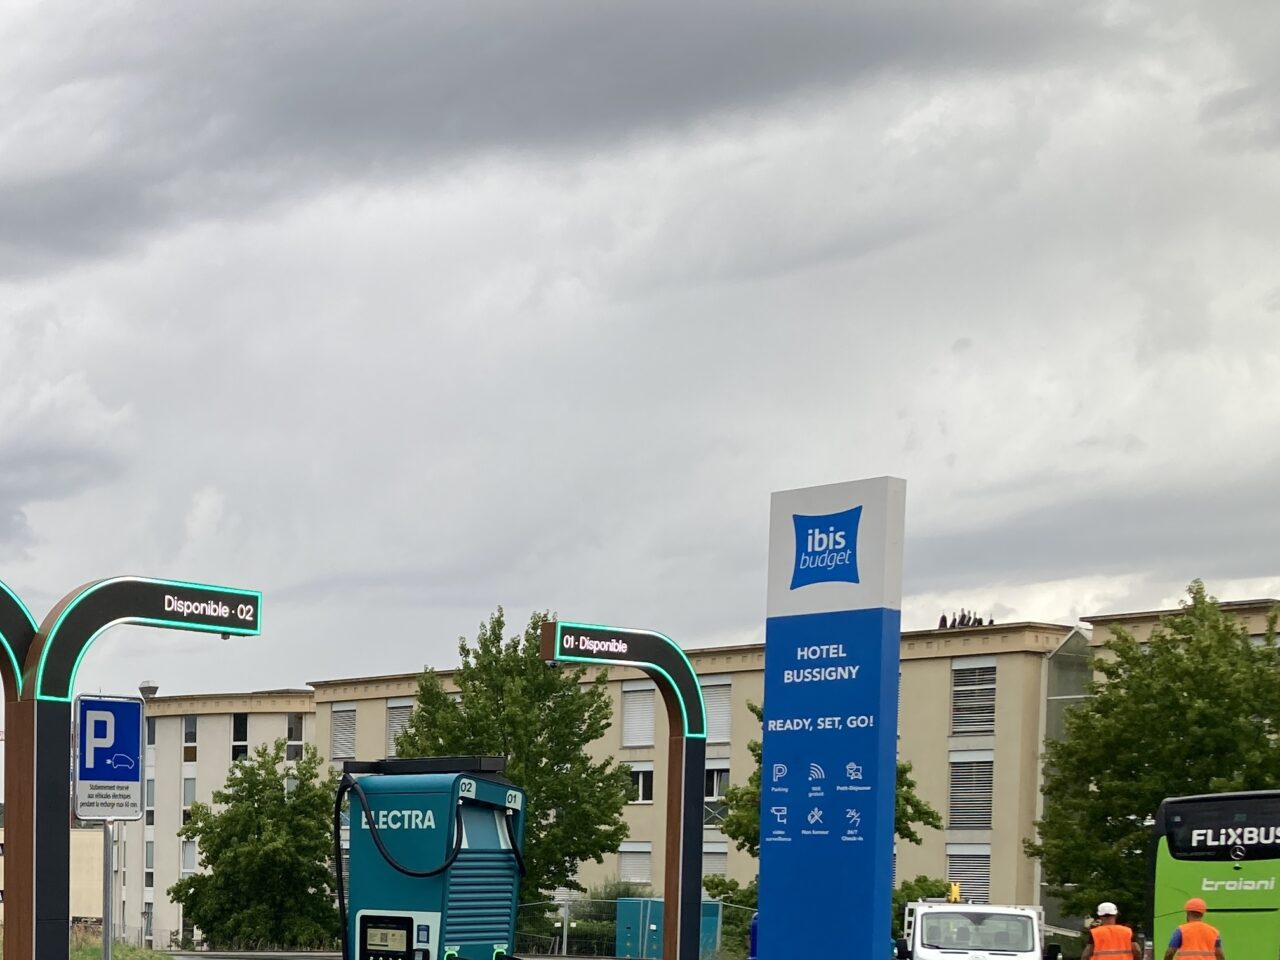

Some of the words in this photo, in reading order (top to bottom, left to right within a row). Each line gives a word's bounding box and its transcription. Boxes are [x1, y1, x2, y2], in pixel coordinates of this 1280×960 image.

[807, 526, 846, 553] ibis
[800, 549, 852, 571] budget
[164, 594, 230, 617] Disponible
[237, 603, 254, 621] 02
[563, 635, 575, 649] 01
[579, 635, 628, 654] Disponible
[797, 644, 847, 660] HOTEL
[784, 665, 860, 684] BUSSIGNY
[768, 718, 813, 732] READY,
[816, 717, 843, 731] SET,
[846, 715, 874, 728] GO!
[85, 709, 115, 769] P
[460, 782, 472, 793] 02
[507, 793, 517, 804] 01
[1201, 876, 1276, 891] troiani
